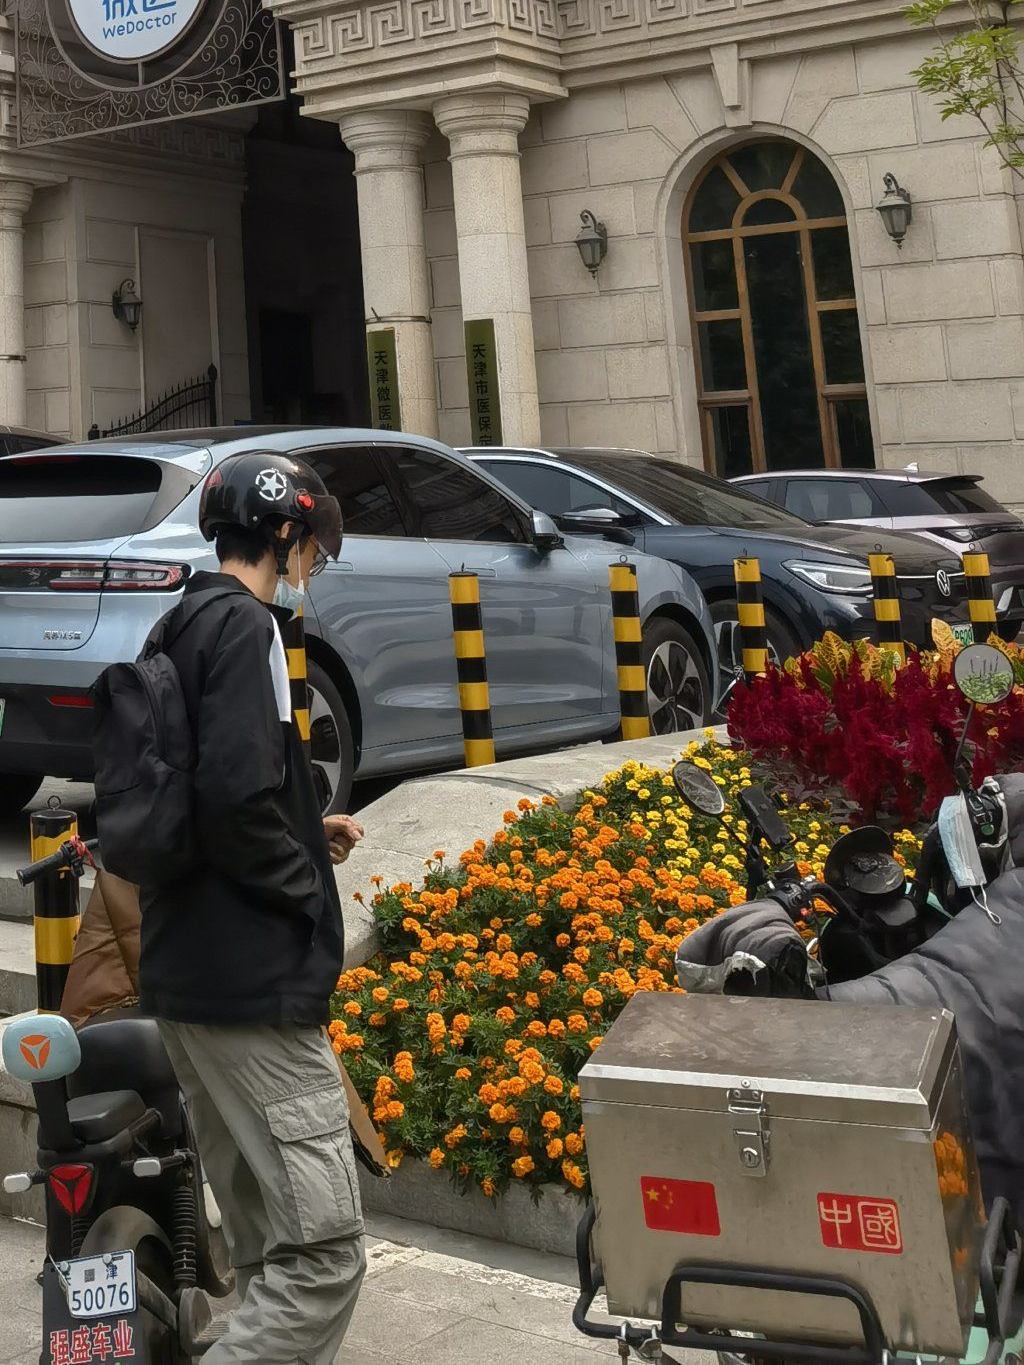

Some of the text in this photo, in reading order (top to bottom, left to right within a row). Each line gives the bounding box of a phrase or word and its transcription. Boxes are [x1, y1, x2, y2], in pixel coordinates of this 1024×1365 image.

[820, 1198, 900, 1249] 中國
[71, 1281, 129, 1312] 50076
[50, 1319, 136, 1365] 强盛车业
